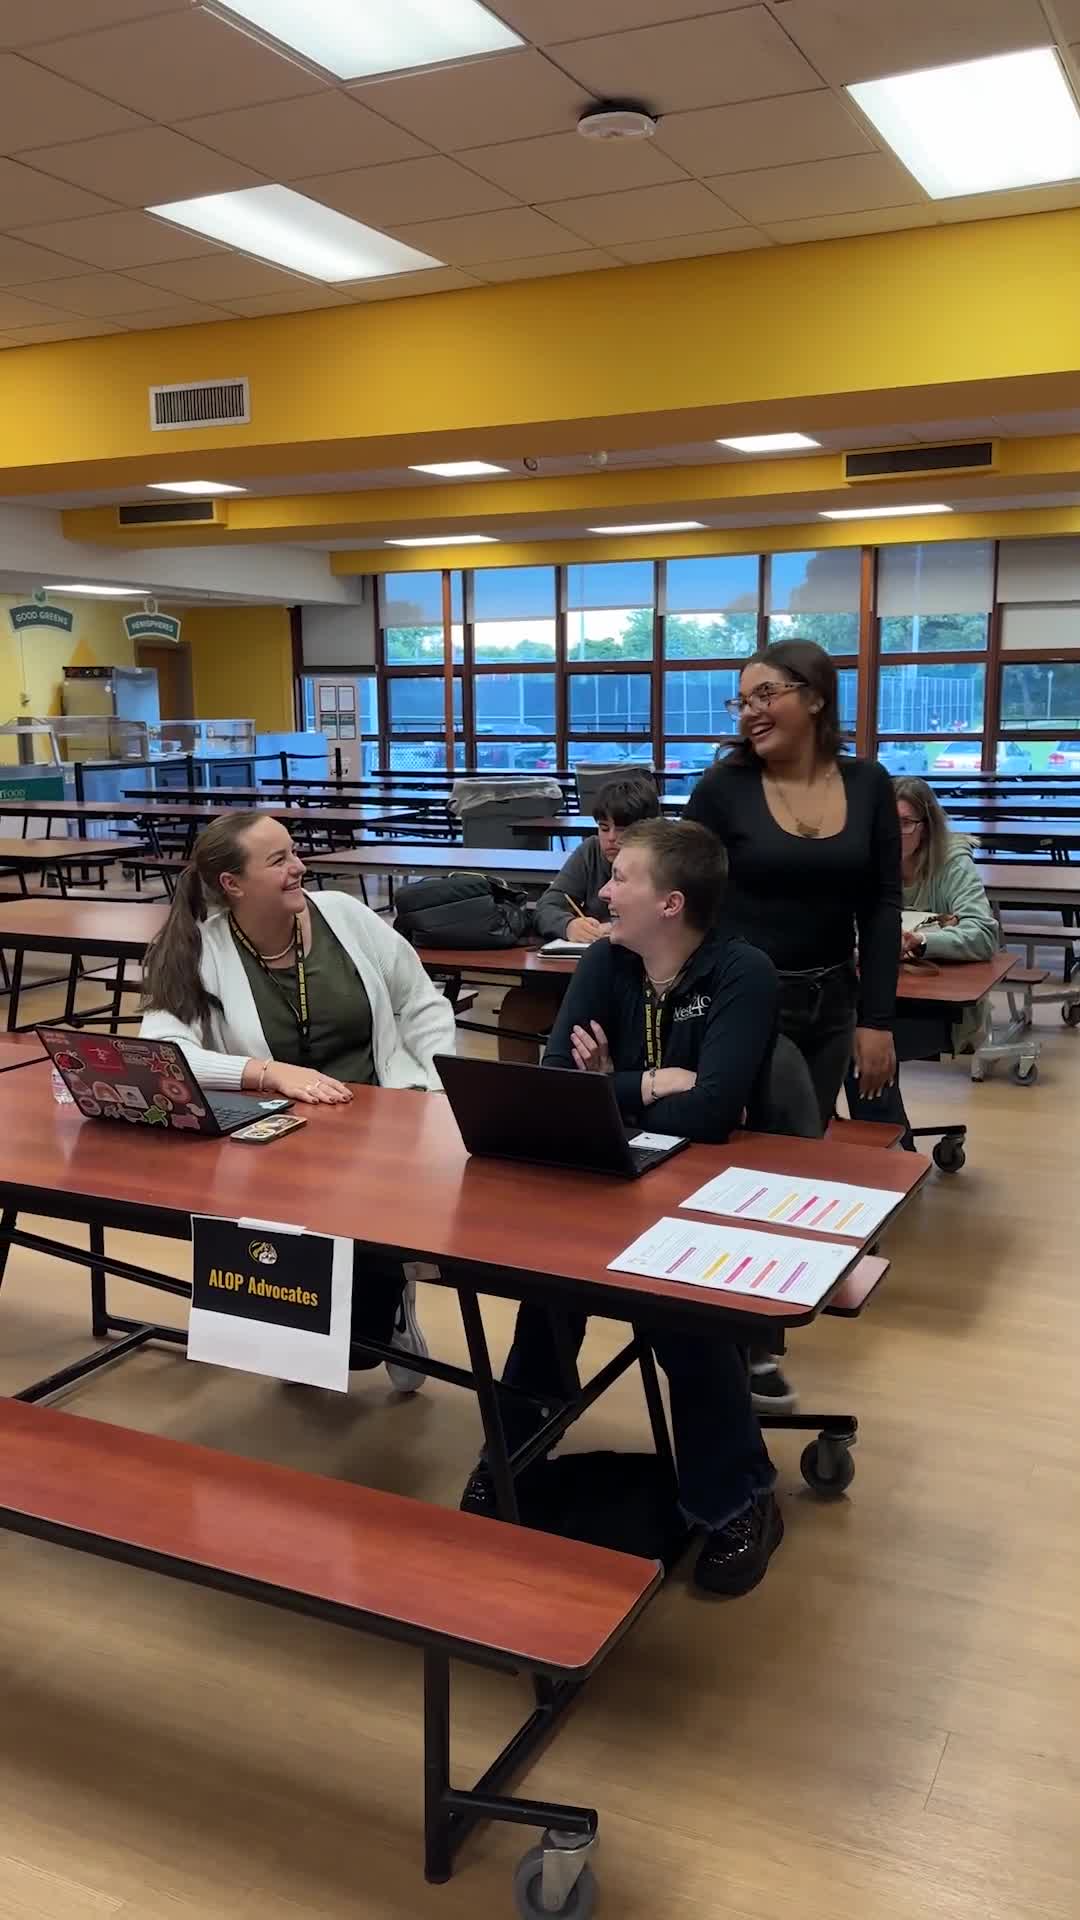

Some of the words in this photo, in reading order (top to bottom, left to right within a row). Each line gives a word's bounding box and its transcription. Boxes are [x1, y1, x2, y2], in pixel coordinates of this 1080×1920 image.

[15, 611, 38, 622] GOOD
[209, 1269, 244, 1291] ALOP
[247, 1276, 319, 1307] Advocates
